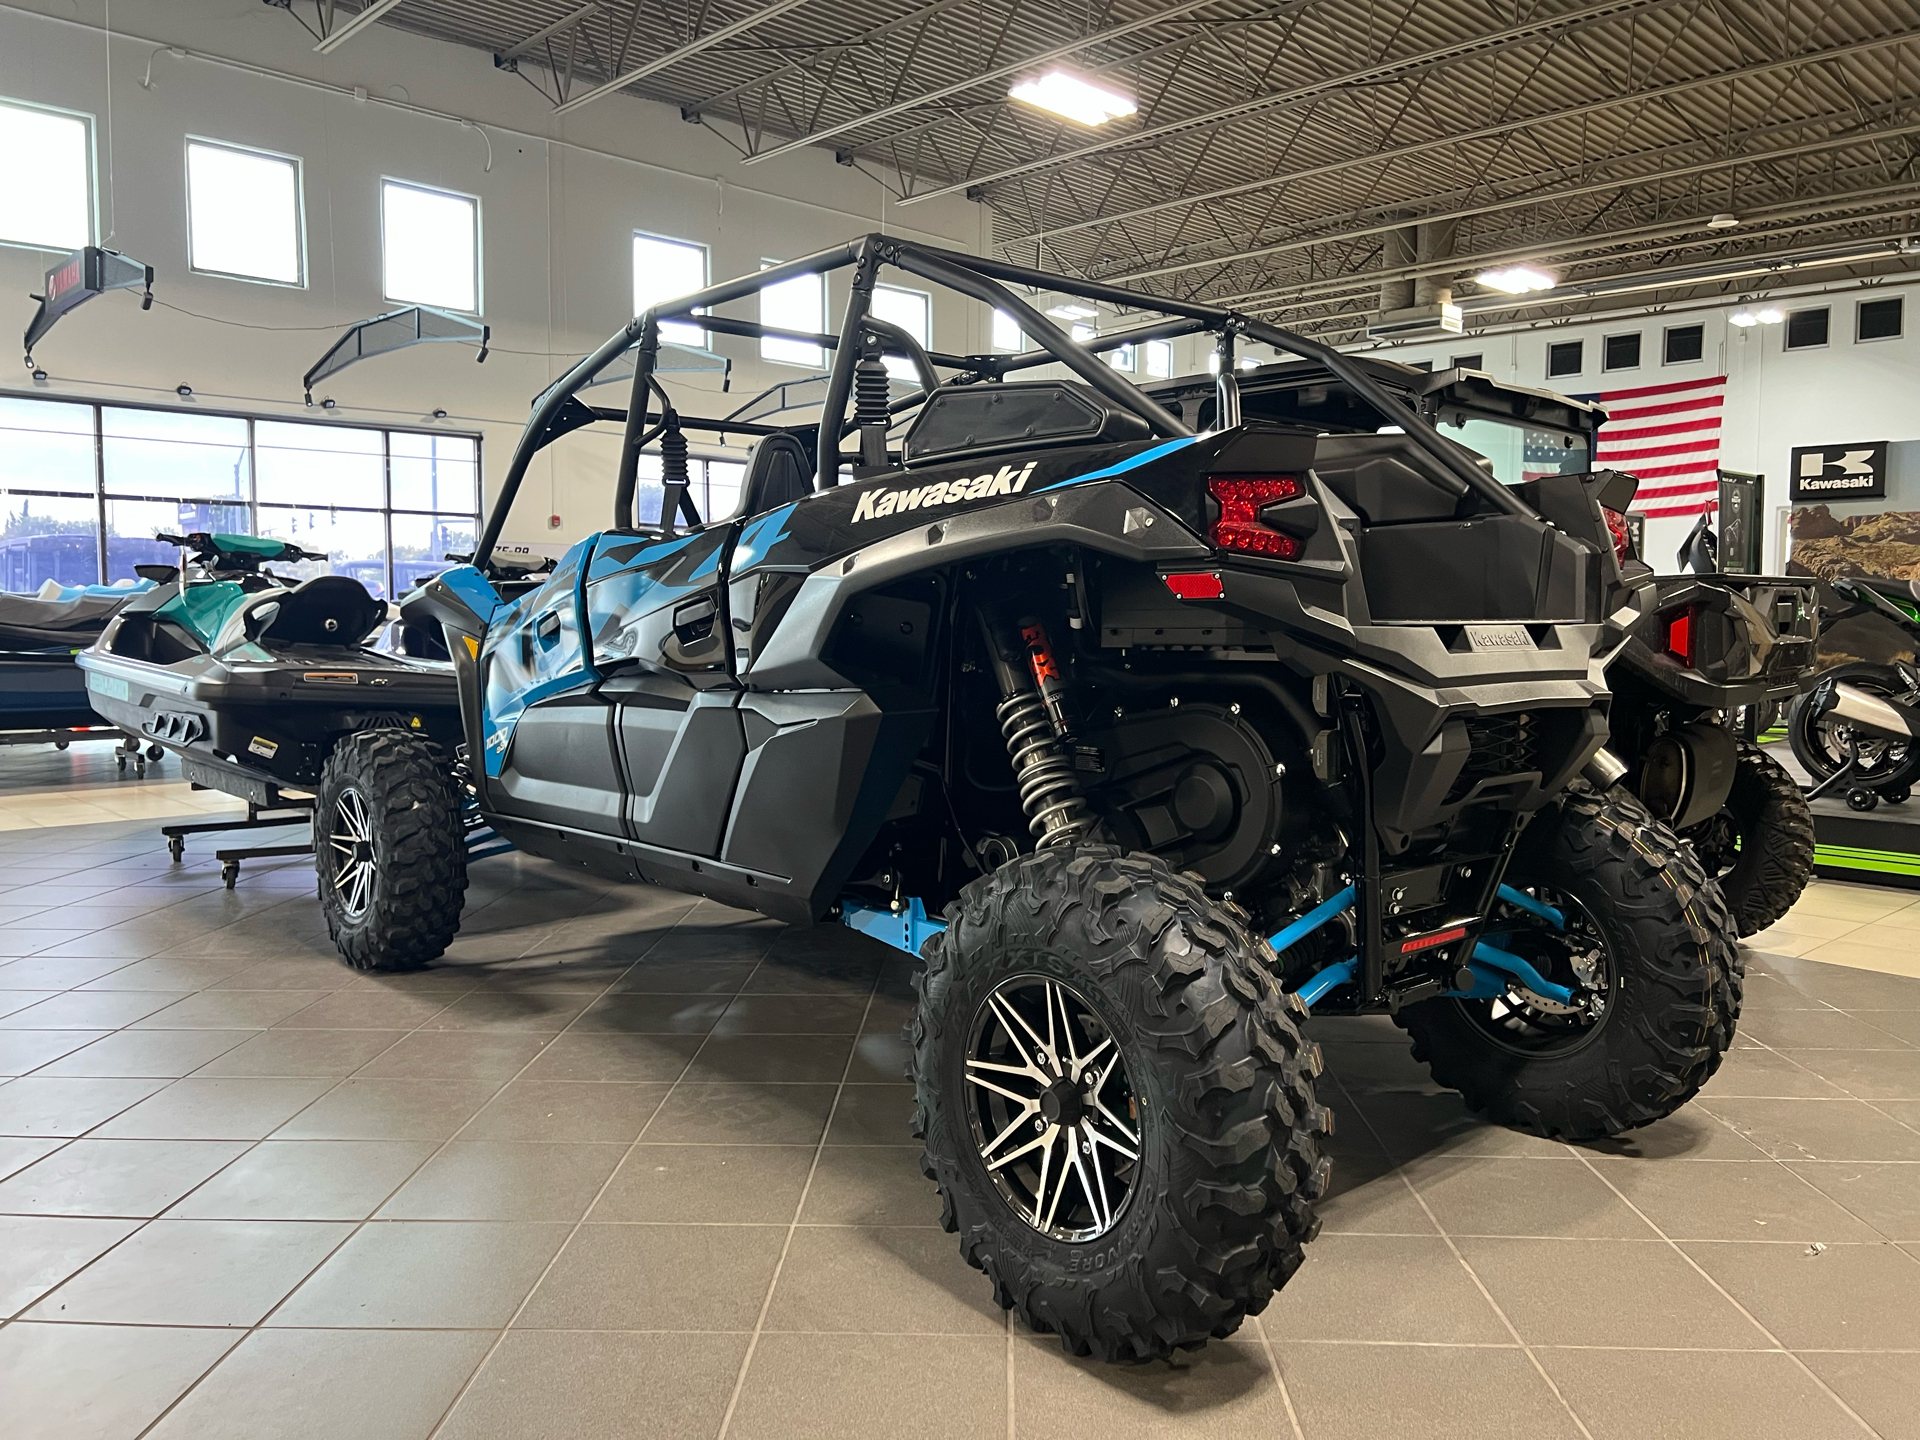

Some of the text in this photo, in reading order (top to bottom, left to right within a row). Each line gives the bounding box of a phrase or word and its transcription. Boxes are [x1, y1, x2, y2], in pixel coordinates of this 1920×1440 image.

[1799, 475, 1874, 491] Kawasaki
[851, 461, 1038, 524] Kawasaki
[1469, 630, 1531, 647] Kawasaki
